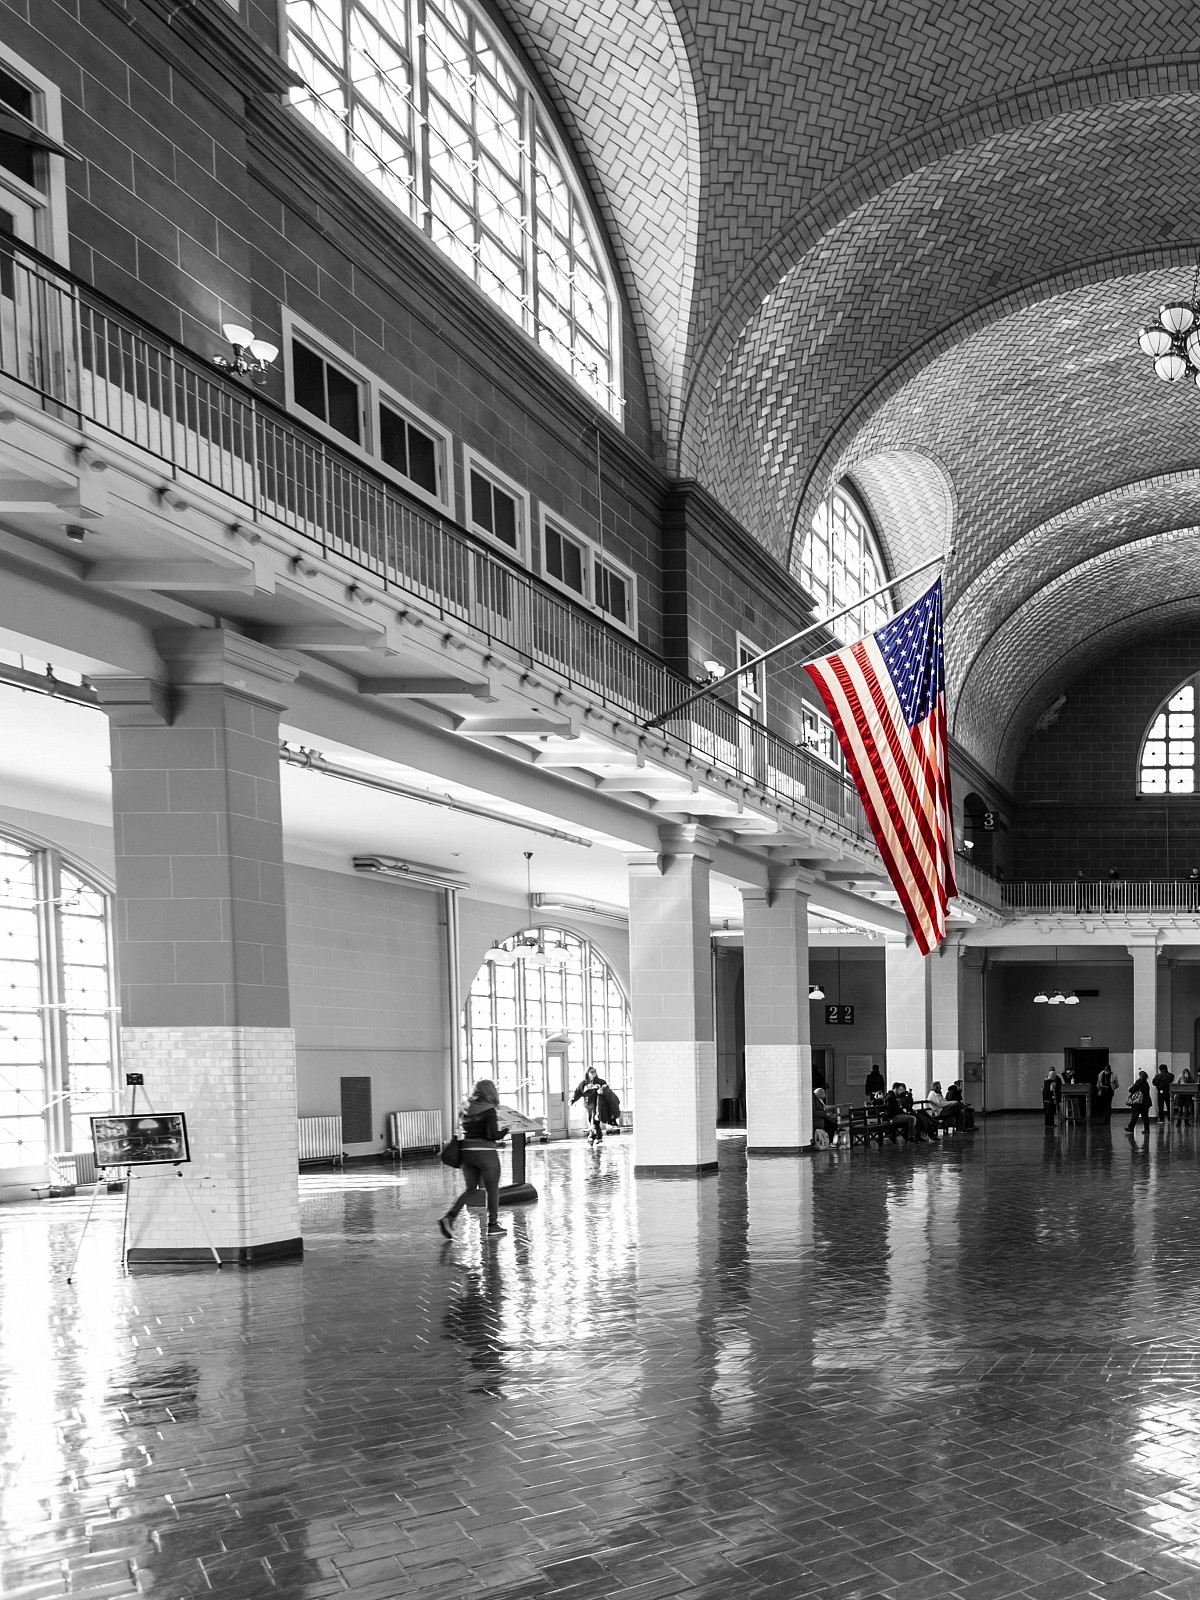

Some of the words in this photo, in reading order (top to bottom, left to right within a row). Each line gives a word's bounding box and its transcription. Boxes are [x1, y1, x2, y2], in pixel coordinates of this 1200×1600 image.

[984, 812, 994, 826] 3
[829, 1006, 838, 1019] 2
[844, 1007, 851, 1019] 2
